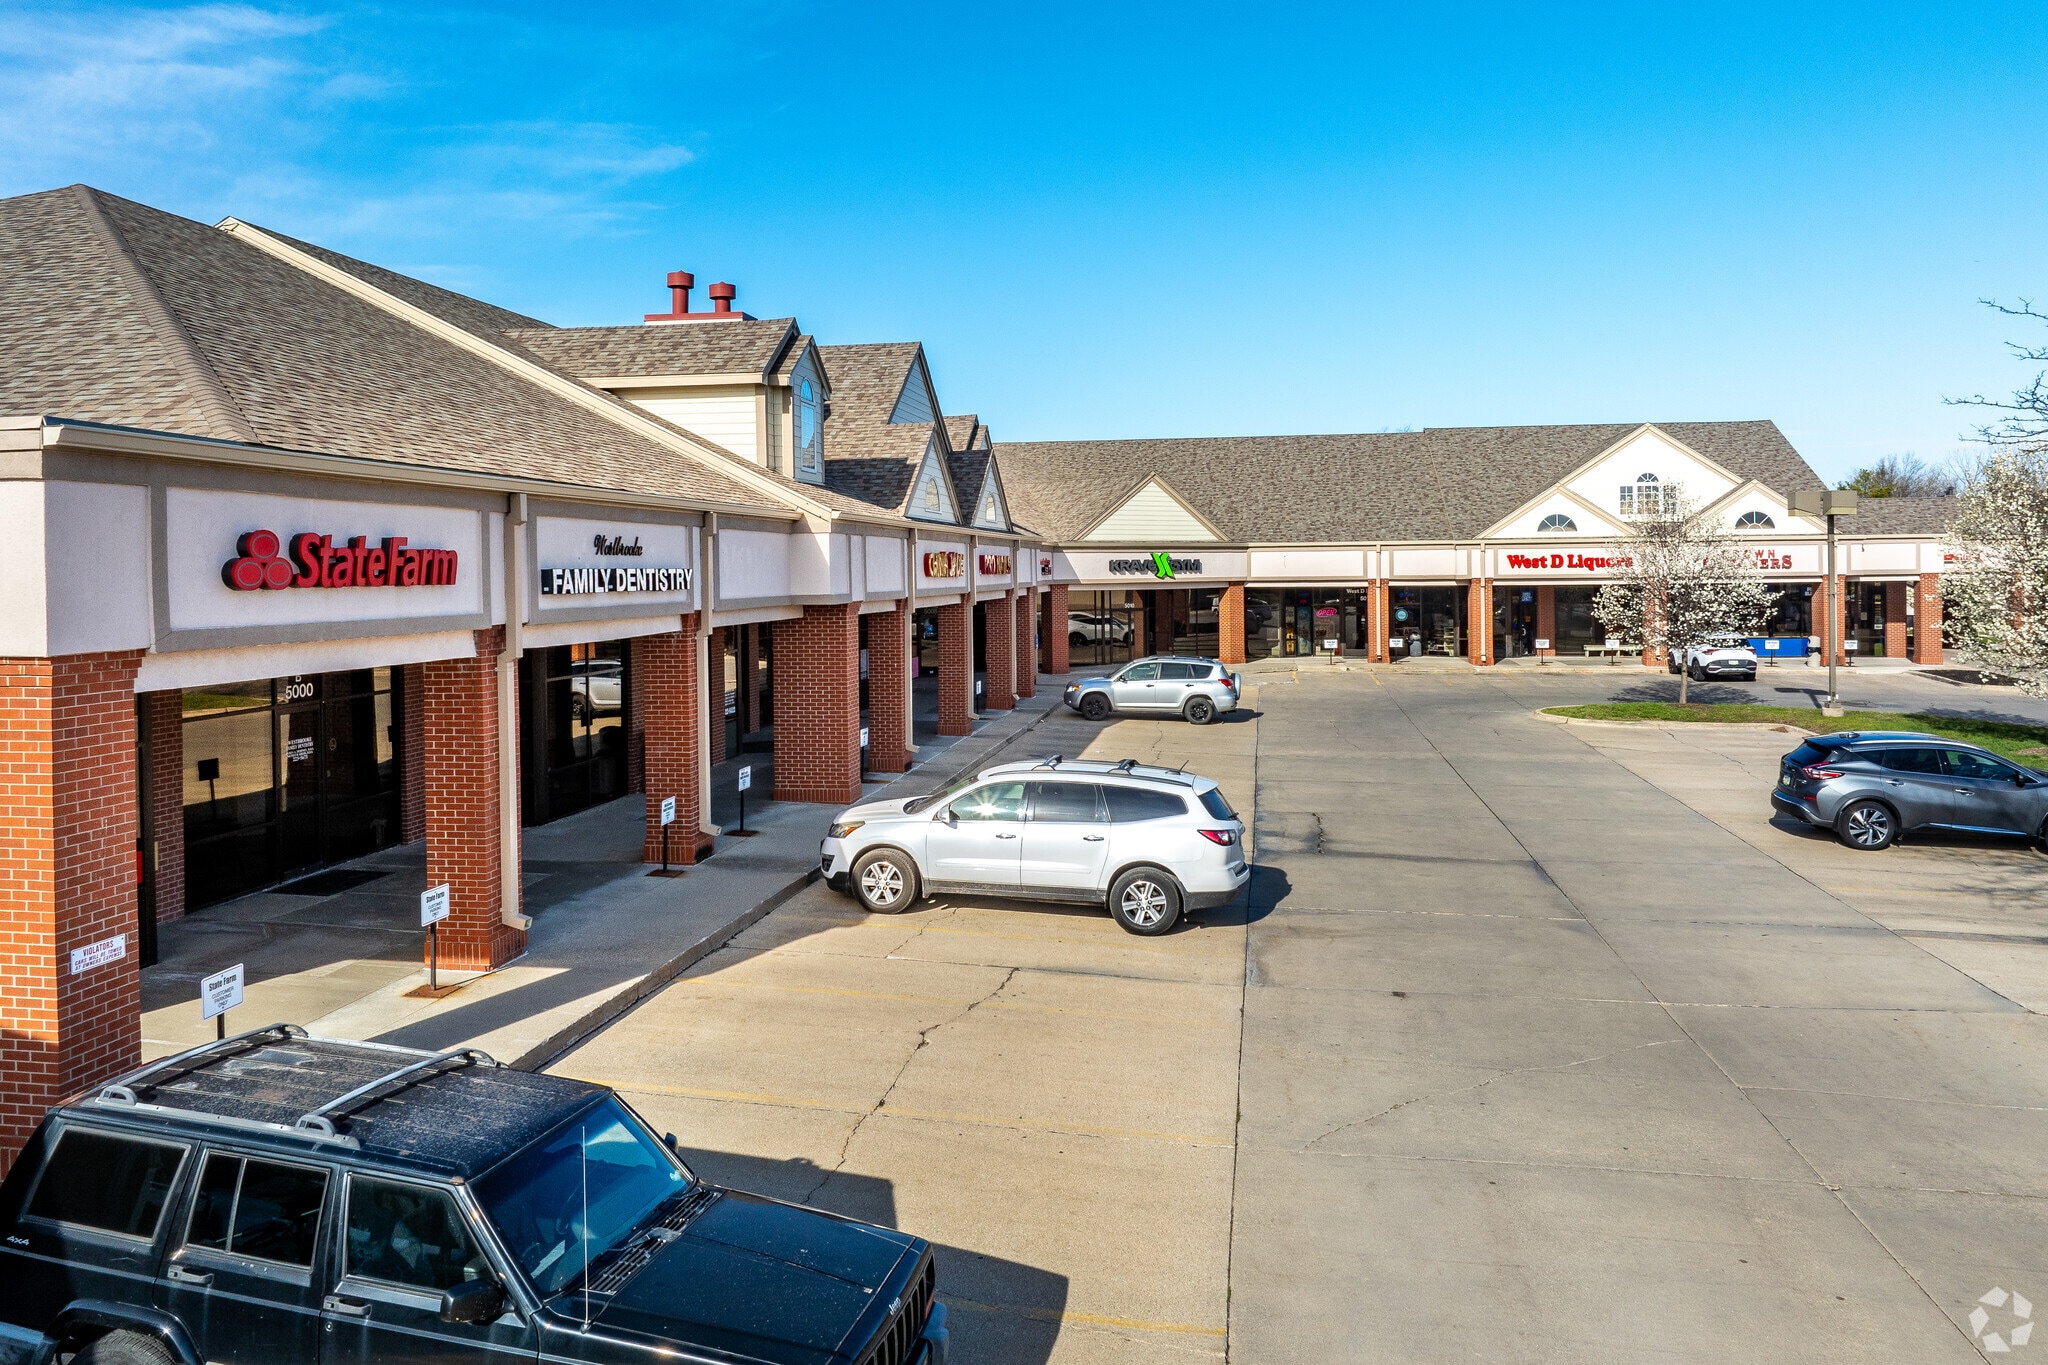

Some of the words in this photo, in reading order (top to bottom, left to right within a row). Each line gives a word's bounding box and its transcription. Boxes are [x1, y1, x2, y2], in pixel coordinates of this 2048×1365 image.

[1507, 554, 1548, 569] West
[1550, 554, 1564, 568] D
[552, 568, 612, 594] FAMILY
[615, 568, 693, 592] DENTISTRY
[1317, 608, 1335, 616] OPEN
[285, 682, 314, 700] 5000
[82, 940, 114, 957] VIOLATORS
[103, 950, 123, 962] EXPENSE
[208, 979, 223, 992] State
[223, 974, 237, 986] Farm
[211, 985, 235, 1000] CUSTOMER
[214, 992, 233, 1004] PARKING
[218, 999, 229, 1008] ONLY
